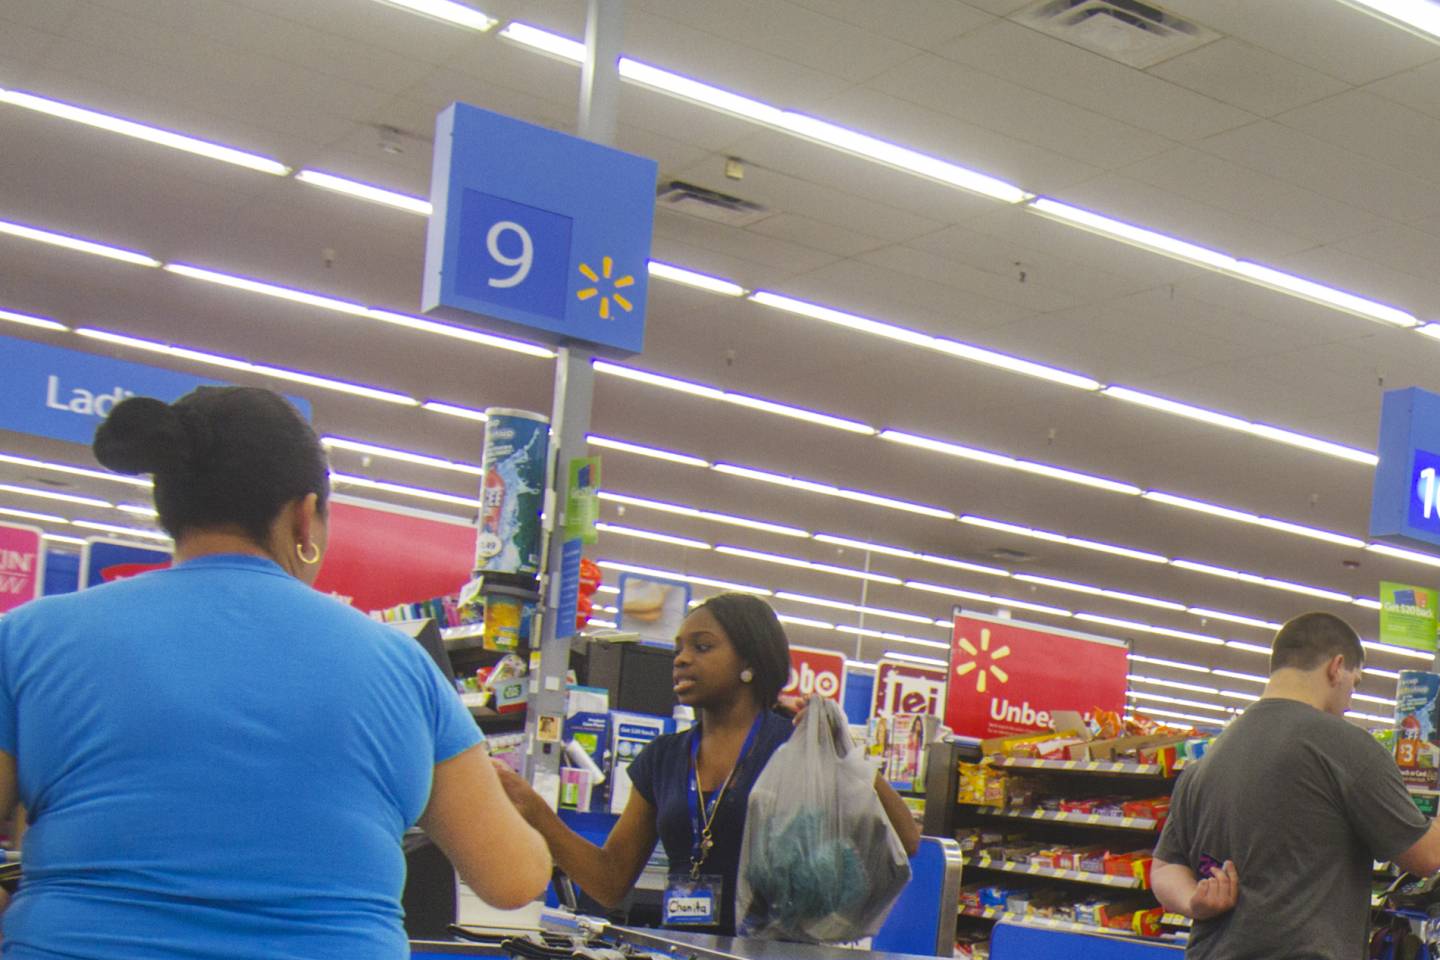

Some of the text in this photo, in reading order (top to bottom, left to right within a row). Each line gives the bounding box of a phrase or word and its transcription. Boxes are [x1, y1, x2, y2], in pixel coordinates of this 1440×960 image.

[486, 220, 534, 289] 9
[46, 375, 136, 418] Lad
[990, 697, 1056, 729] Unbe
[1400, 743, 1413, 762] $3
